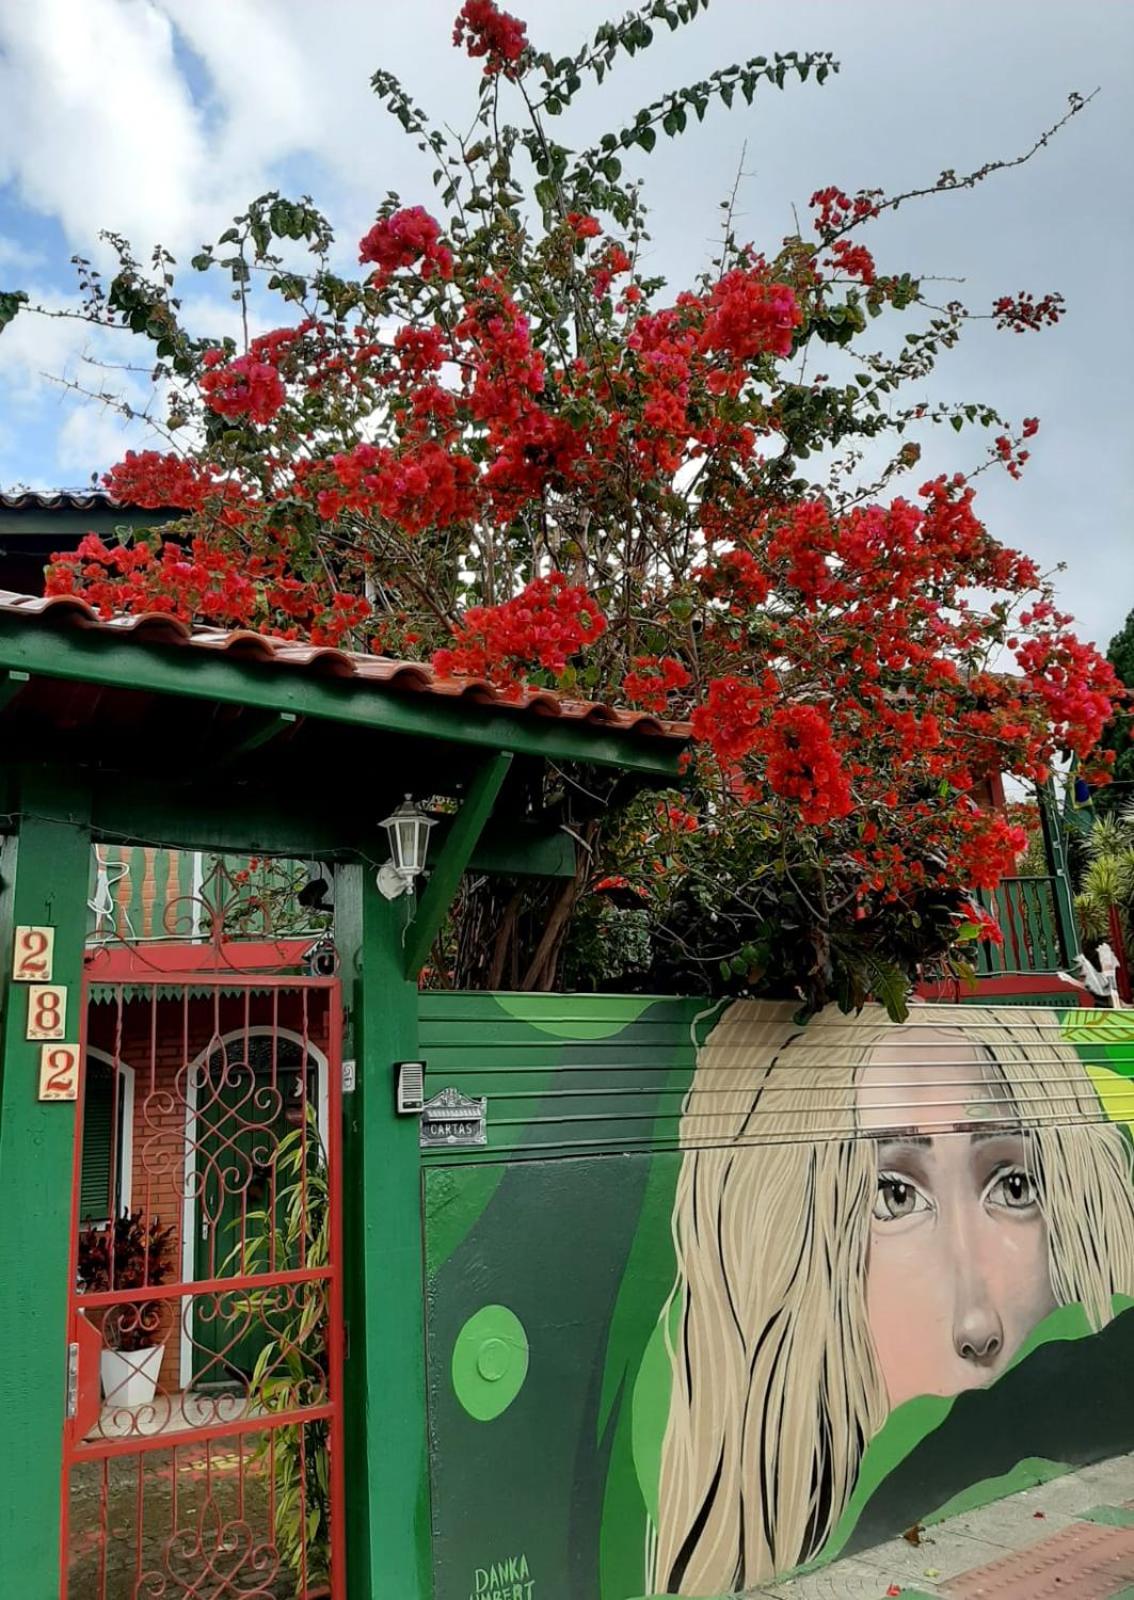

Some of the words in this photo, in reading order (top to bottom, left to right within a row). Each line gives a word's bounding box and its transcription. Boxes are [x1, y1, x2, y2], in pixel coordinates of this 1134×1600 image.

[430, 1122, 473, 1135] CARTAS
[475, 1553, 529, 1593] DANKA
[469, 1580, 535, 1600] ERT
